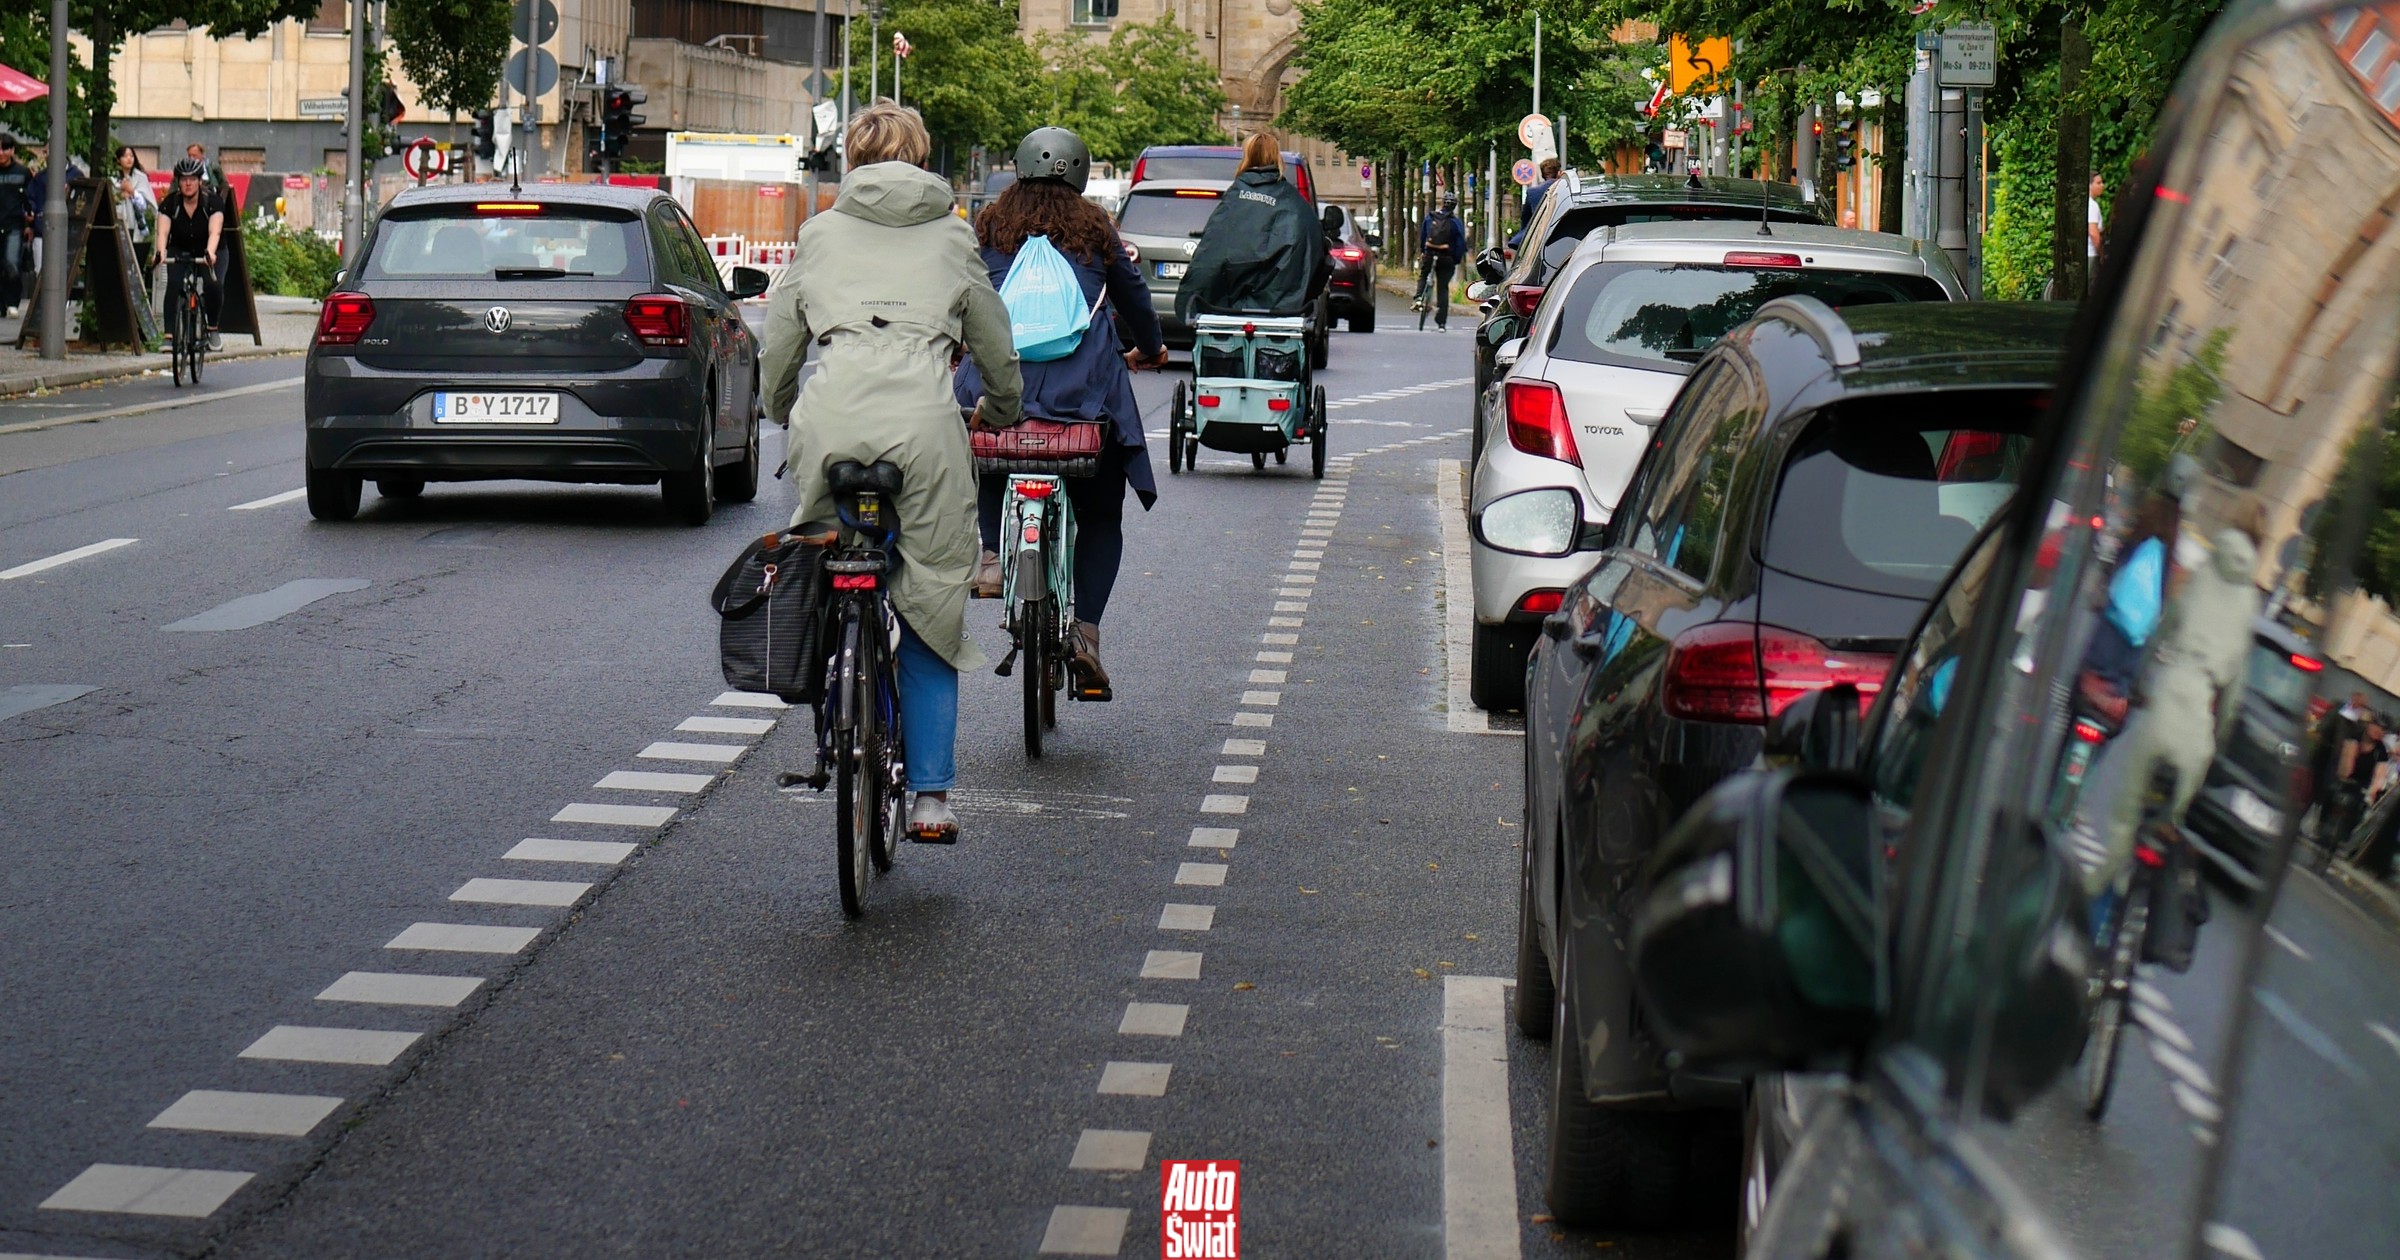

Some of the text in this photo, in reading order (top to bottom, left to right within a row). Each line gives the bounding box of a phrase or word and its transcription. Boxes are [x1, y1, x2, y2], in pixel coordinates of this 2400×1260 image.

[1943, 61, 1962, 70] Mo-Sa
[1164, 264, 1171, 275] B
[363, 338, 389, 346] POLO
[455, 396, 551, 415] B Y 1717
[1584, 425, 1624, 436] TOYOTA
